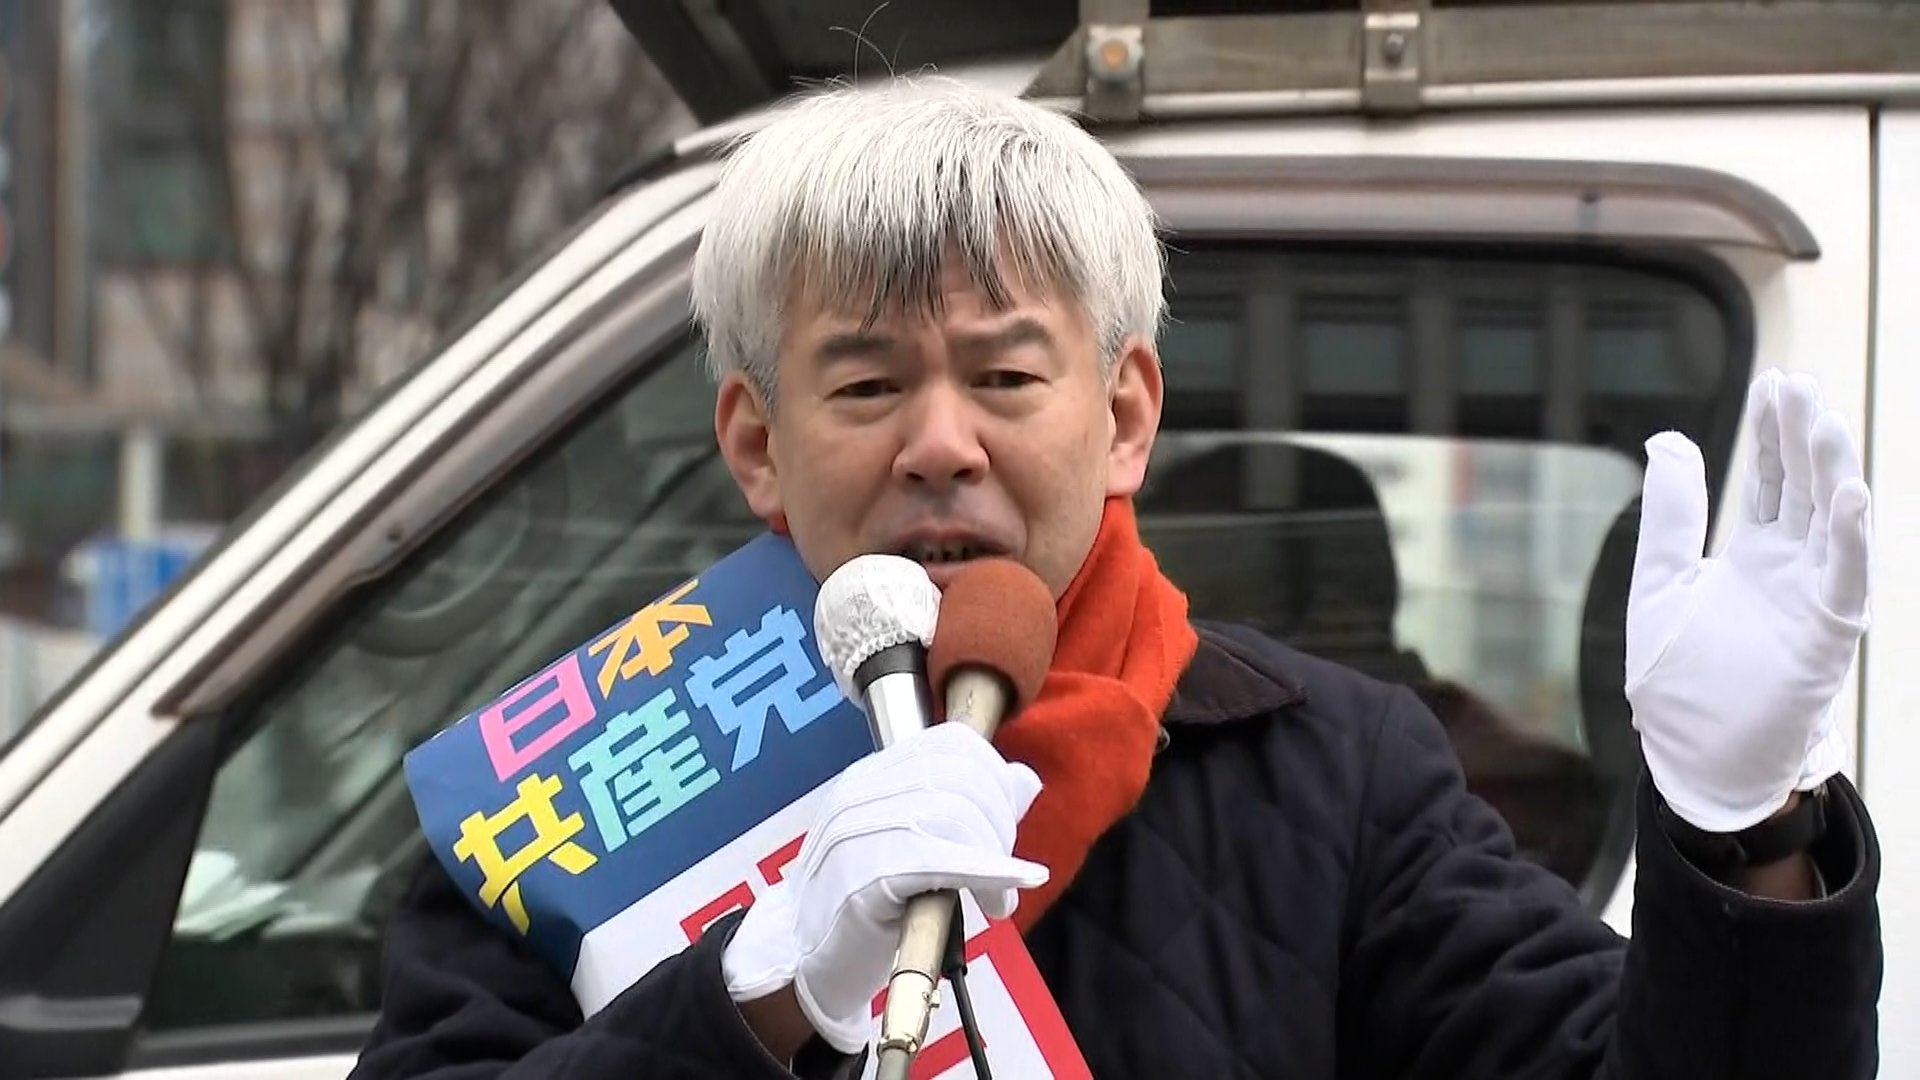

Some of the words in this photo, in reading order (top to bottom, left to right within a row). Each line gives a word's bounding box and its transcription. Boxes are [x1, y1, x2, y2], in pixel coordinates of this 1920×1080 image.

[453, 604, 845, 936] 共産党
[478, 578, 713, 783] 日本
